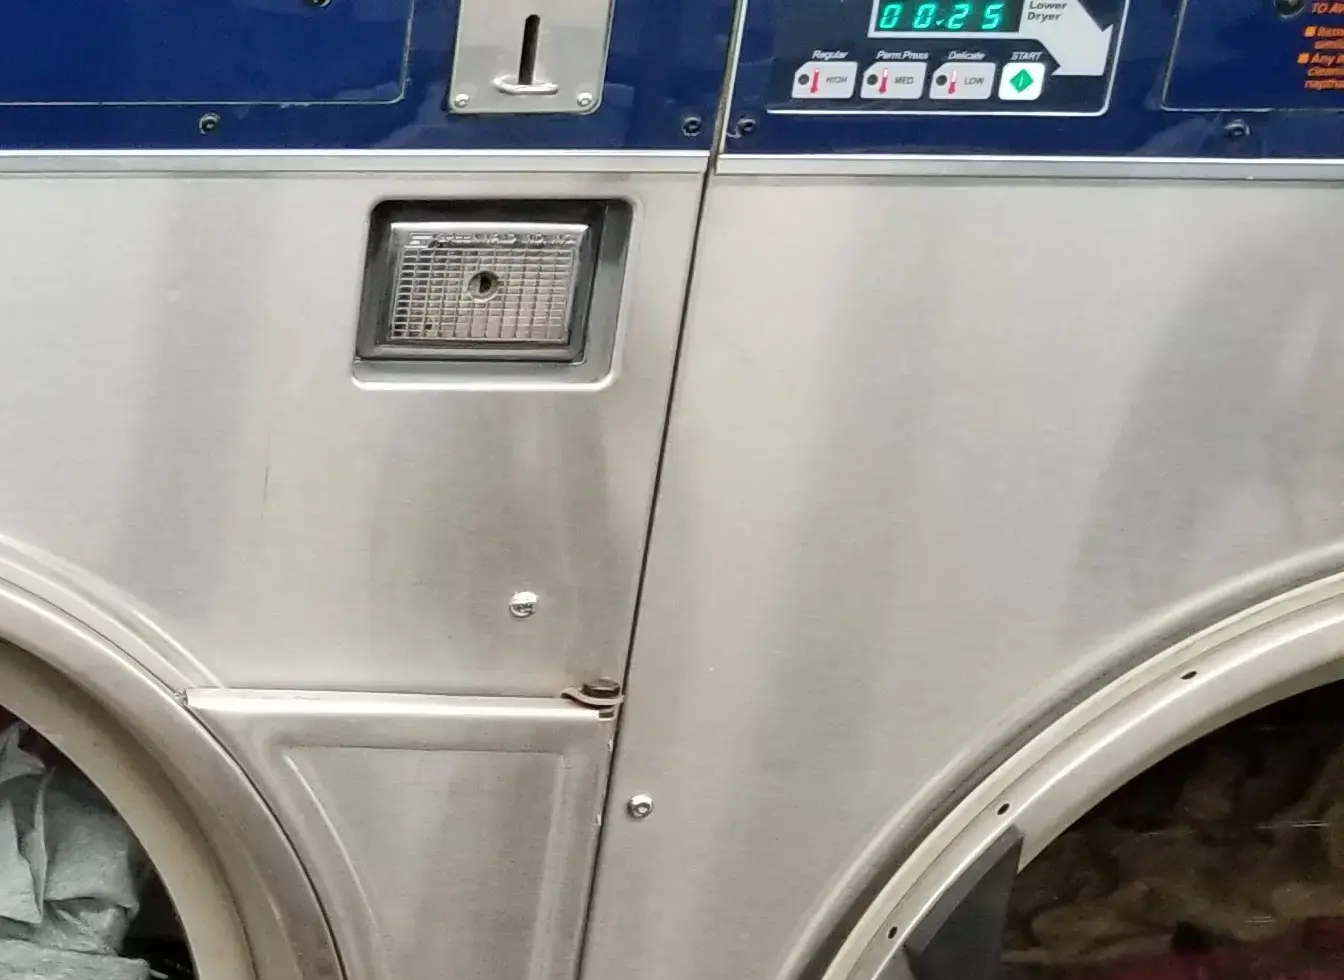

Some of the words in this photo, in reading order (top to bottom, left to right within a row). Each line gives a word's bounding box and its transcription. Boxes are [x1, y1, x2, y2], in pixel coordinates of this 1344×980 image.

[1028, 0, 1068, 10] Lower
[1026, 12, 1062, 22] Dryer
[812, 50, 849, 60] Regular
[947, 50, 987, 60] Delicate
[1011, 52, 1043, 61] START
[964, 76, 985, 85] LOW
